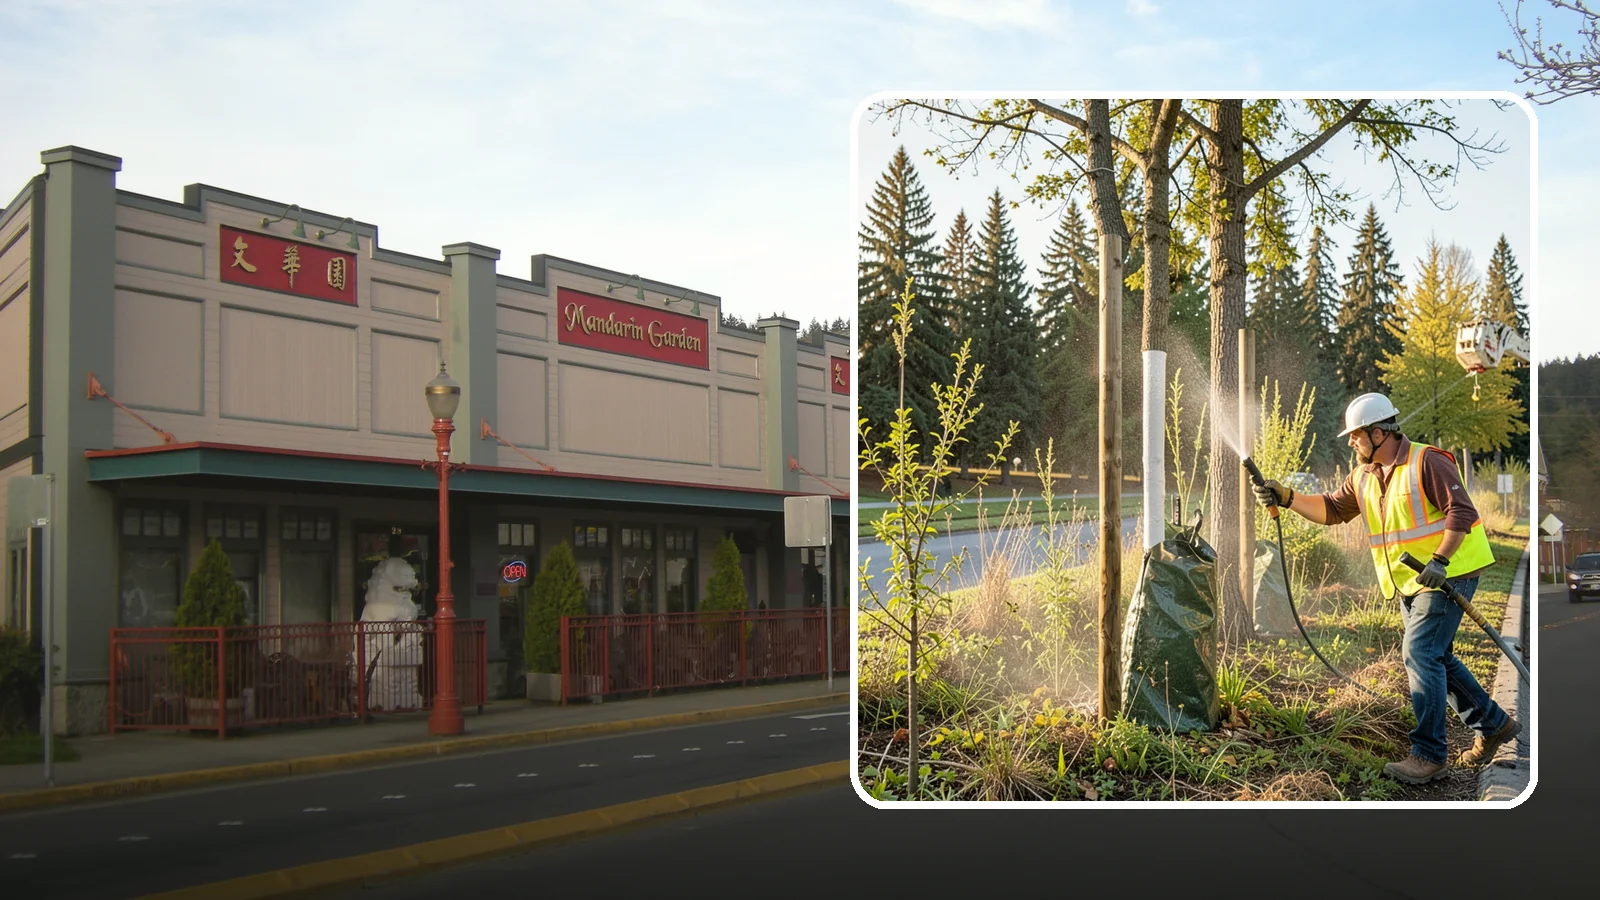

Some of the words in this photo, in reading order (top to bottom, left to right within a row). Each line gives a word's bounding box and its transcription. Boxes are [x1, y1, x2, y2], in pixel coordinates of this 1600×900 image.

[564, 302, 644, 341] Mandarin
[647, 320, 702, 352] Garden
[503, 565, 527, 578] OPEN
